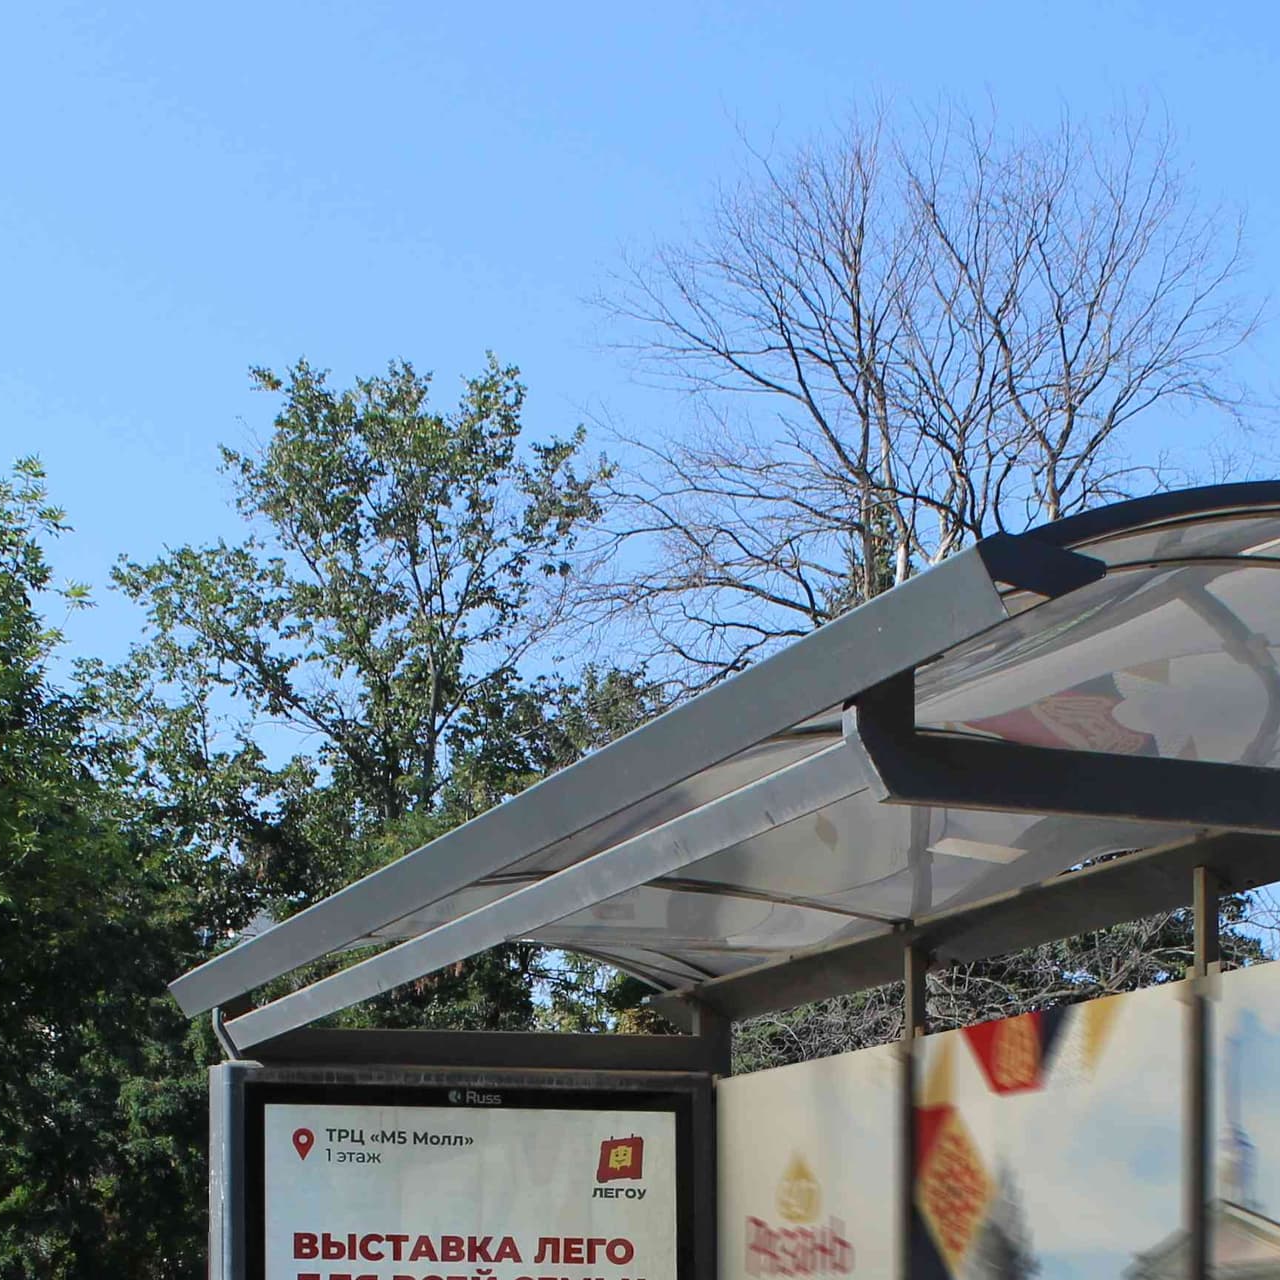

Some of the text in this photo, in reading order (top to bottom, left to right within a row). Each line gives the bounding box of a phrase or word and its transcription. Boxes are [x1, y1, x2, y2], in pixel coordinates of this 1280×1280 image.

[466, 1090, 502, 1105] Russ
[325, 1128, 474, 1147] ТРЦ «М5 Молл»
[325, 1148, 382, 1164] 1 этаж
[592, 1187, 648, 1201] ЛЕГОУ
[293, 1232, 635, 1266] ВЫСТАВКА ЛЕГО
